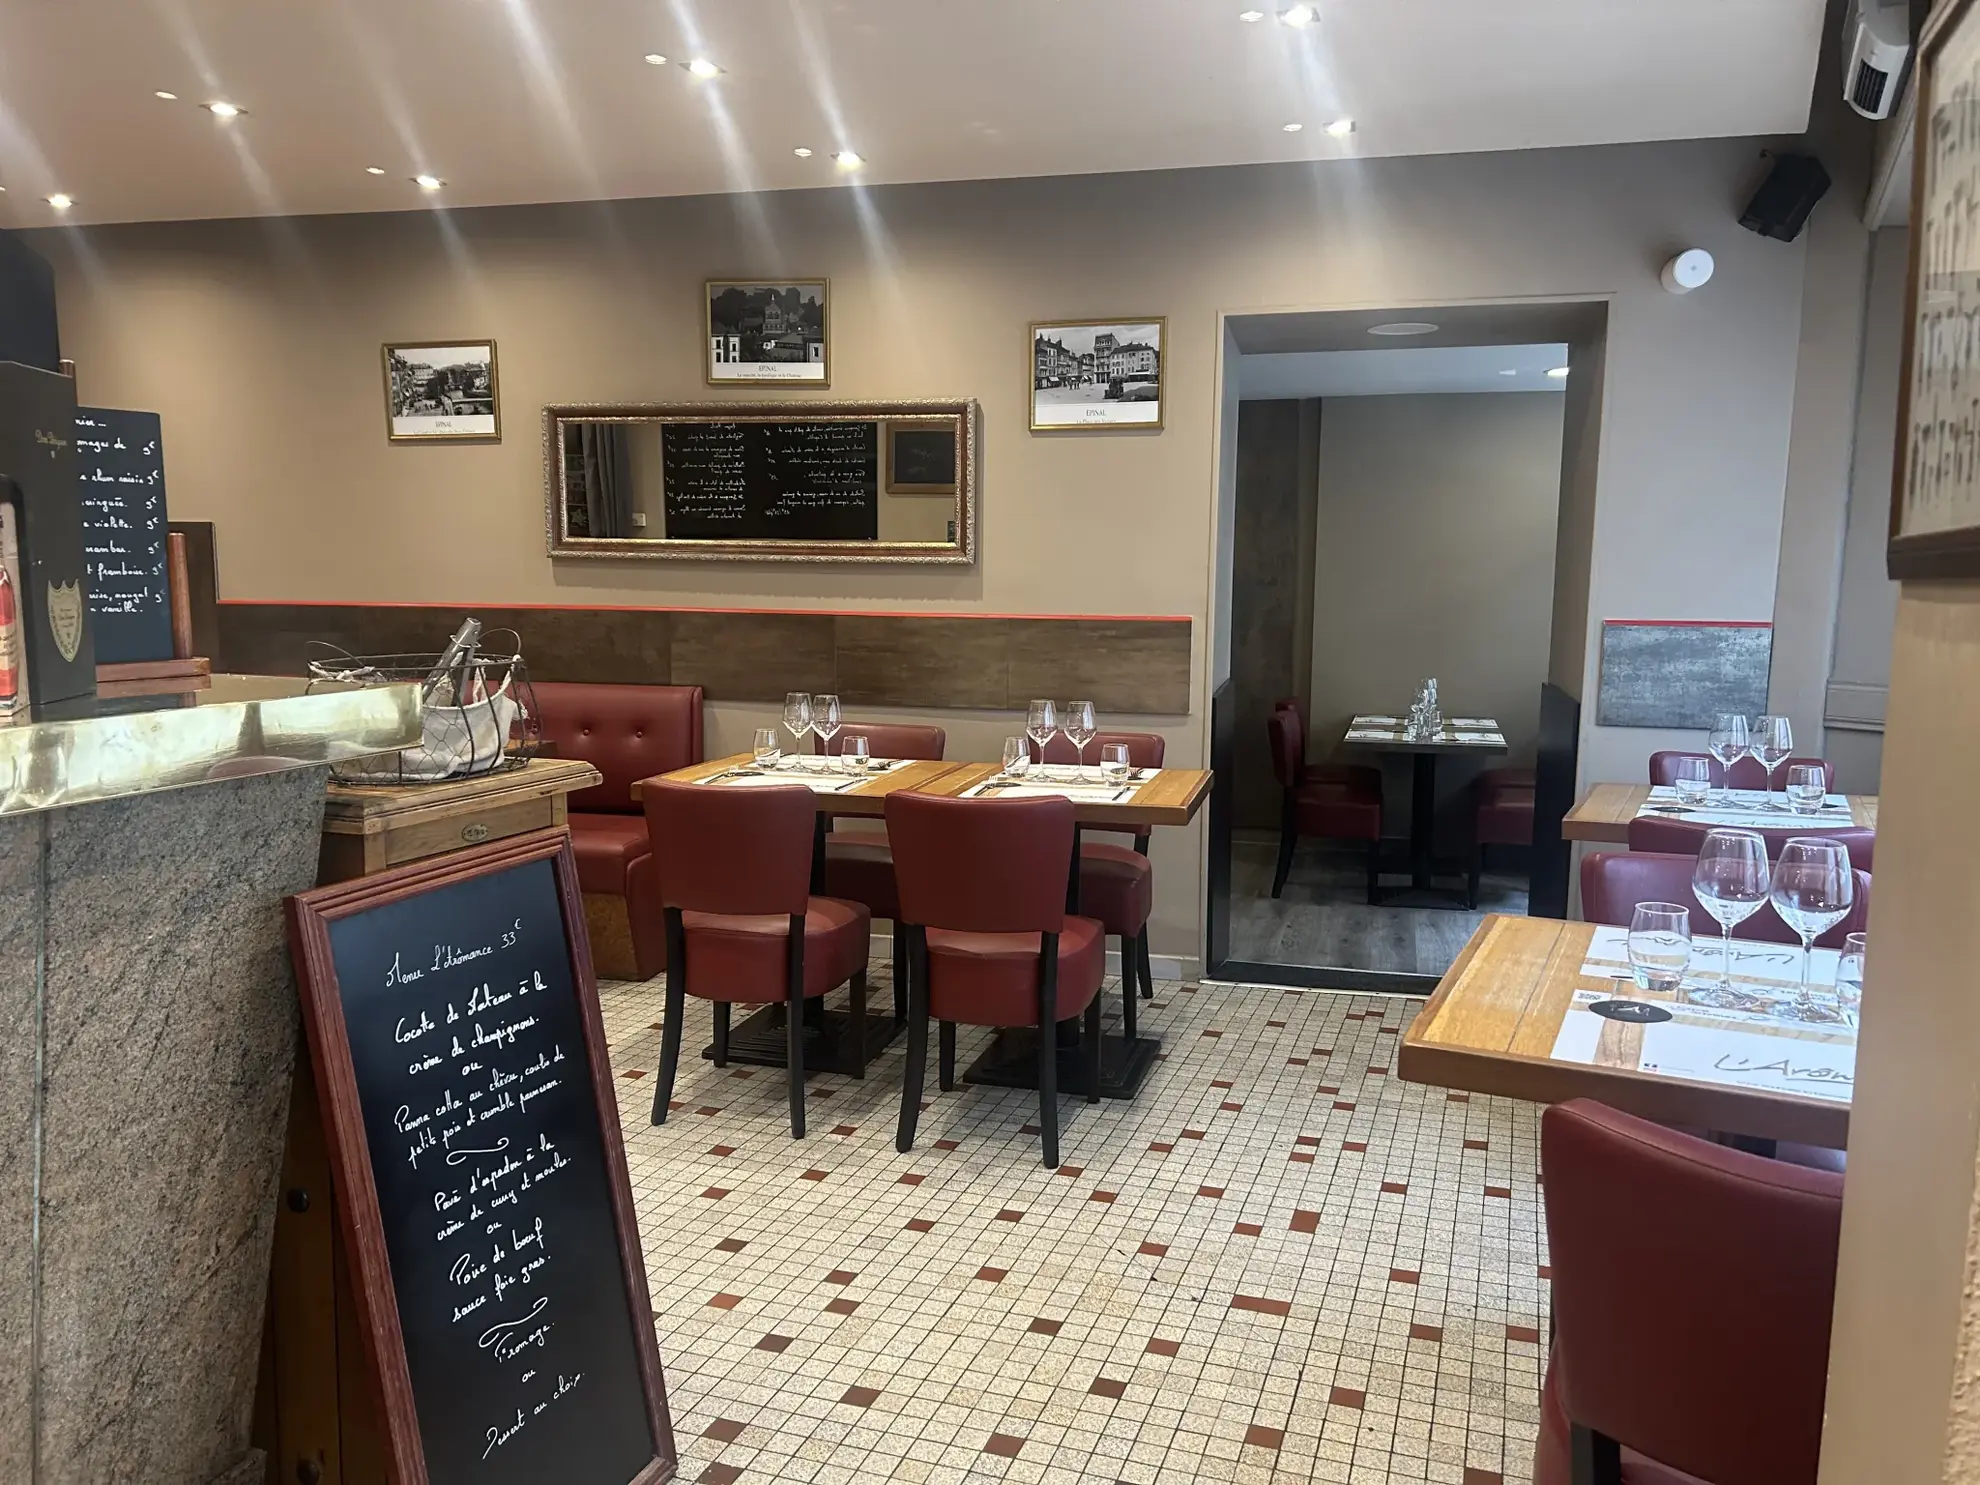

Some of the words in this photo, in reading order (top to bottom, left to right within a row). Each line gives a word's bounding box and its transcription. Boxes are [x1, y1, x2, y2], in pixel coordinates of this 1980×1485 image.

[386, 952, 424, 987] Menu
[395, 1011, 435, 1043] Cocotte
[446, 1004, 459, 1024] de
[534, 970, 547, 991] la
[409, 1055, 442, 1074] crème
[451, 1037, 465, 1057] de
[462, 1061, 483, 1076] ou
[394, 1105, 430, 1133] Panna
[436, 1089, 462, 1115] cotta
[469, 1090, 483, 1101] au
[554, 1044, 565, 1062] de
[408, 1127, 436, 1169] petits
[443, 1121, 461, 1149] pois
[467, 1108, 476, 1126] et
[480, 1092, 514, 1121] crumble
[434, 1191, 461, 1212] Pavé
[540, 1133, 555, 1151] la
[437, 1217, 465, 1241] crème
[470, 1203, 484, 1221] de
[521, 1172, 532, 1191] et
[486, 1220, 502, 1234] ou
[493, 1244, 505, 1263] de
[452, 1296, 486, 1322] sauce
[494, 1272, 515, 1301] foie
[521, 1367, 536, 1382] ou
[482, 1408, 525, 1460] Dessert
[534, 1401, 547, 1415] au
